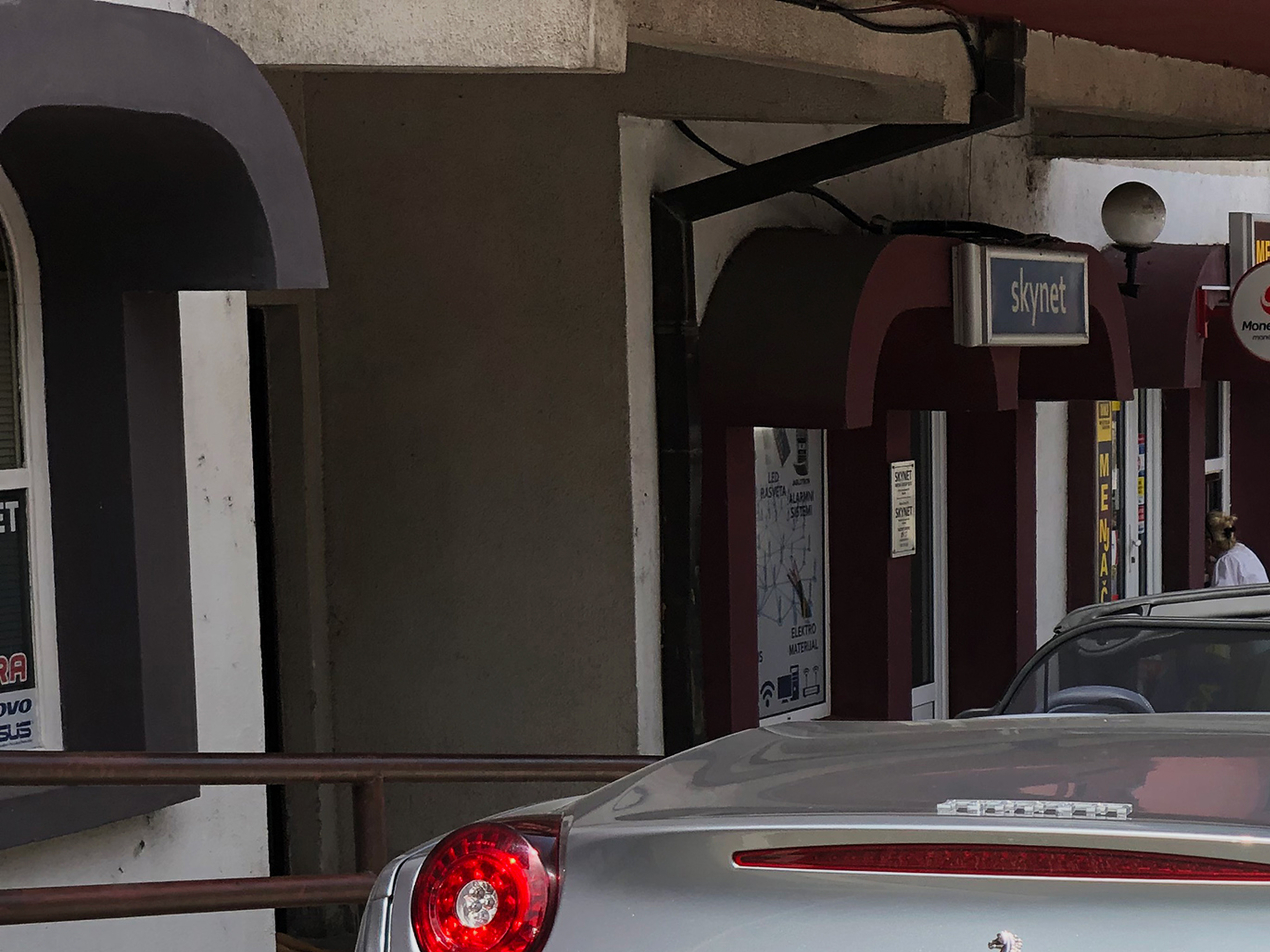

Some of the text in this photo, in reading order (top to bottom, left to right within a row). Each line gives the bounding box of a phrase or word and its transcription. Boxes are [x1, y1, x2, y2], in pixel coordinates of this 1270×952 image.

[1011, 267, 1067, 327] skynet
[767, 471, 780, 484] LED
[894, 470, 912, 482] SKYNET
[895, 506, 913, 518] SKYNET
[791, 623, 817, 639] ELEKTRO
